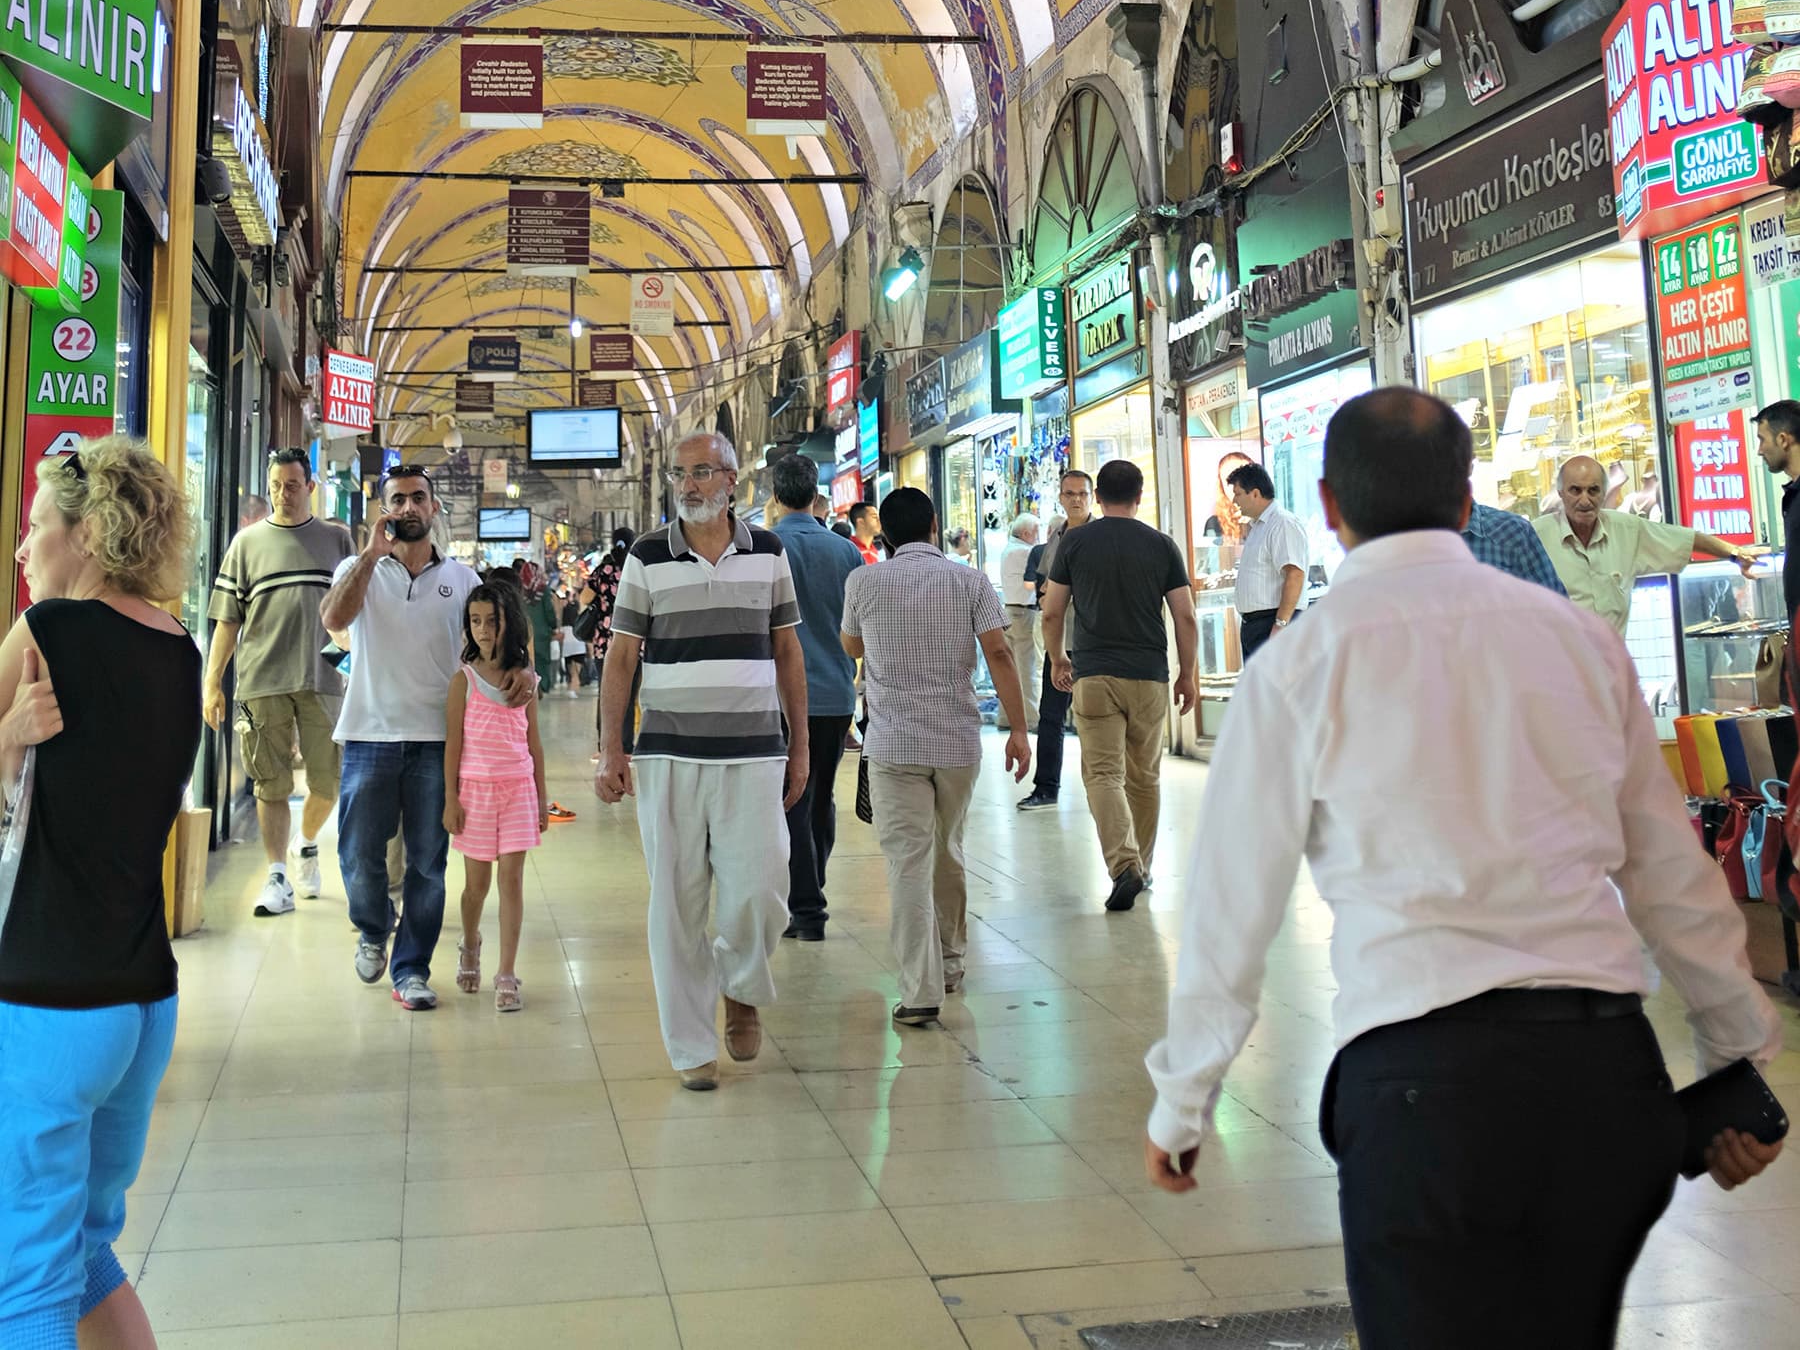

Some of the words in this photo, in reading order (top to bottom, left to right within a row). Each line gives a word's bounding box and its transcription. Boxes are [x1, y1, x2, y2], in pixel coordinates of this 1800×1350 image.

[1606, 18, 1636, 106] ALTIN
[1611, 88, 1642, 166] ALINIR
[1683, 129, 1748, 169] GÖNÜL
[1416, 177, 1499, 244] Kuyumcu
[1504, 123, 1611, 204] Kardeşler
[1598, 194, 1614, 218] 83
[1480, 241, 1489, 257] &
[1527, 203, 1576, 237] KÖKLER
[1660, 246, 1680, 280] 14
[1688, 237, 1709, 272] 18
[1714, 229, 1737, 264] 22
[1753, 244, 1783, 275] TAKSİT
[1663, 280, 1682, 294] AYAR
[1690, 272, 1709, 286] AYAR
[1719, 262, 1738, 277] AYAR
[1670, 298, 1698, 328] HER
[1700, 284, 1735, 321] ÇEŞİT
[58, 326, 92, 351] 22
[1043, 290, 1060, 366] SILVER
[1268, 329, 1296, 368] PIRLANTA
[1296, 334, 1302, 356] &
[1303, 314, 1333, 354] ALYANS
[1666, 329, 1701, 361] ALTIN
[1705, 318, 1748, 350] ALINIR
[486, 347, 517, 358] POLİS
[37, 371, 107, 405] AYAR
[329, 376, 373, 404] ALTIN
[328, 400, 371, 428] ALINIR
[1690, 435, 1740, 471] ÇEŞİT
[1693, 475, 1744, 500] ALTIN
[1693, 510, 1752, 535] ALINIR
